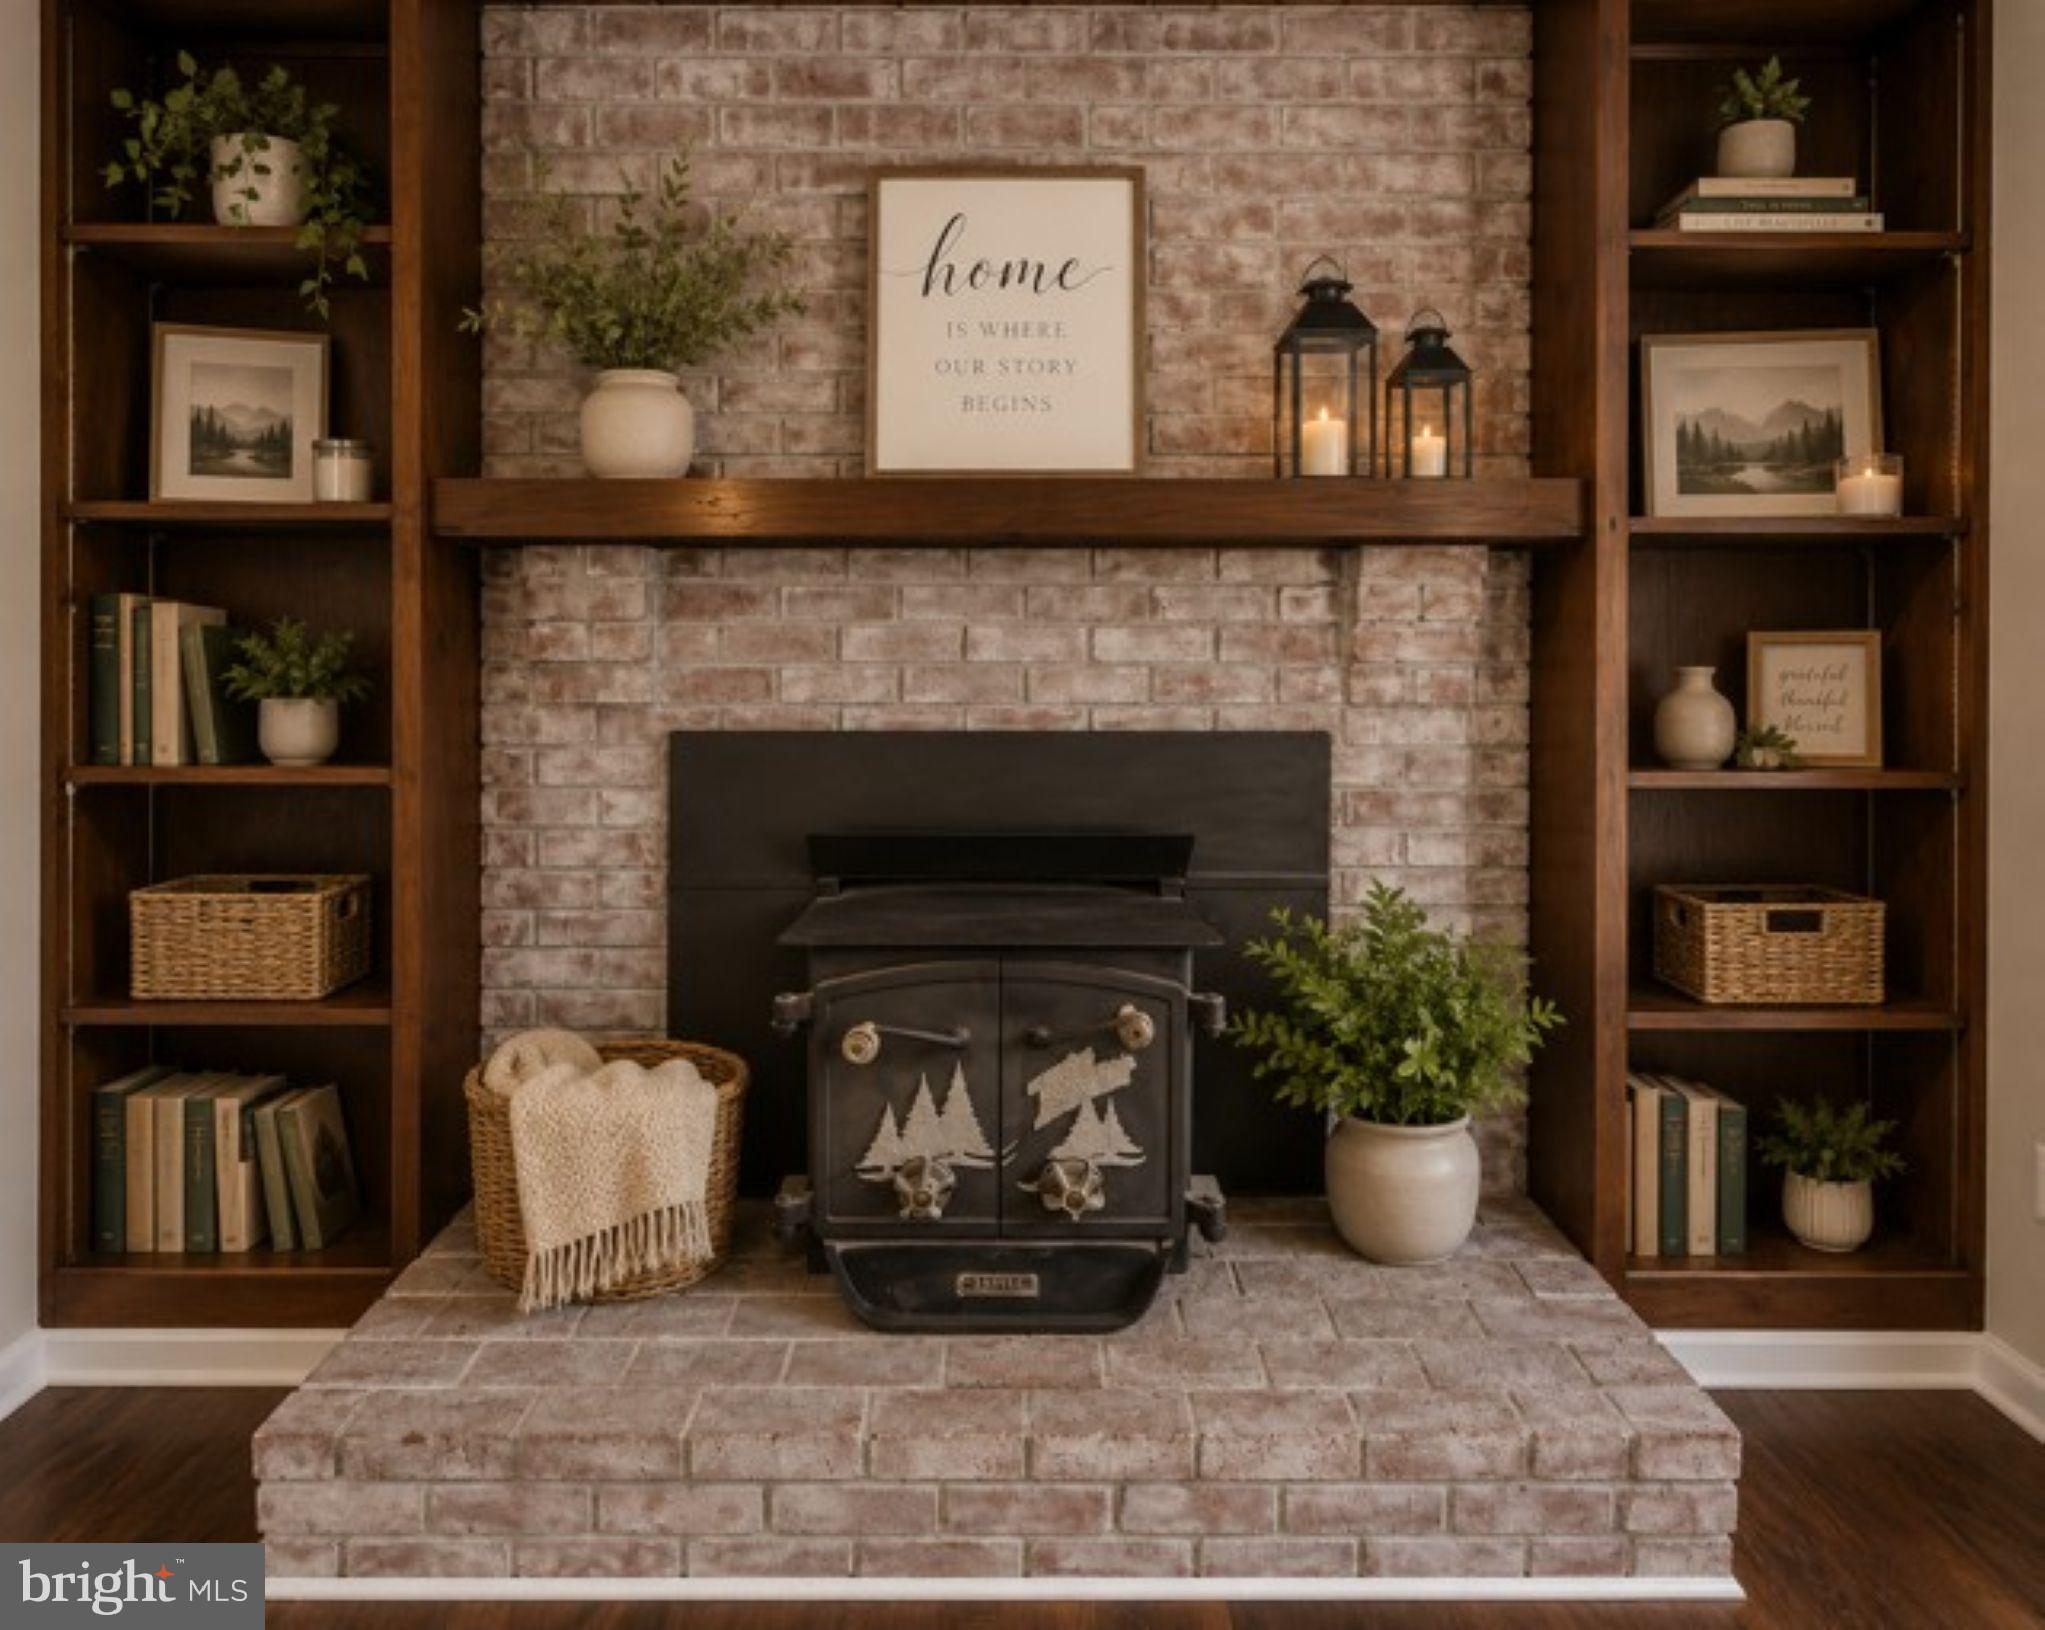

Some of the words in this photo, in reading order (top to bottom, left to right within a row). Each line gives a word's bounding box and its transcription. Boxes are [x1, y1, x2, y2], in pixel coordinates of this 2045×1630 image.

[892, 212, 1113, 297] home
[946, 321, 968, 339] IS
[979, 321, 1068, 339] WHERE
[934, 359, 986, 375] OUR
[998, 358, 1078, 375] STORY
[961, 395, 1052, 413] BEGINS
